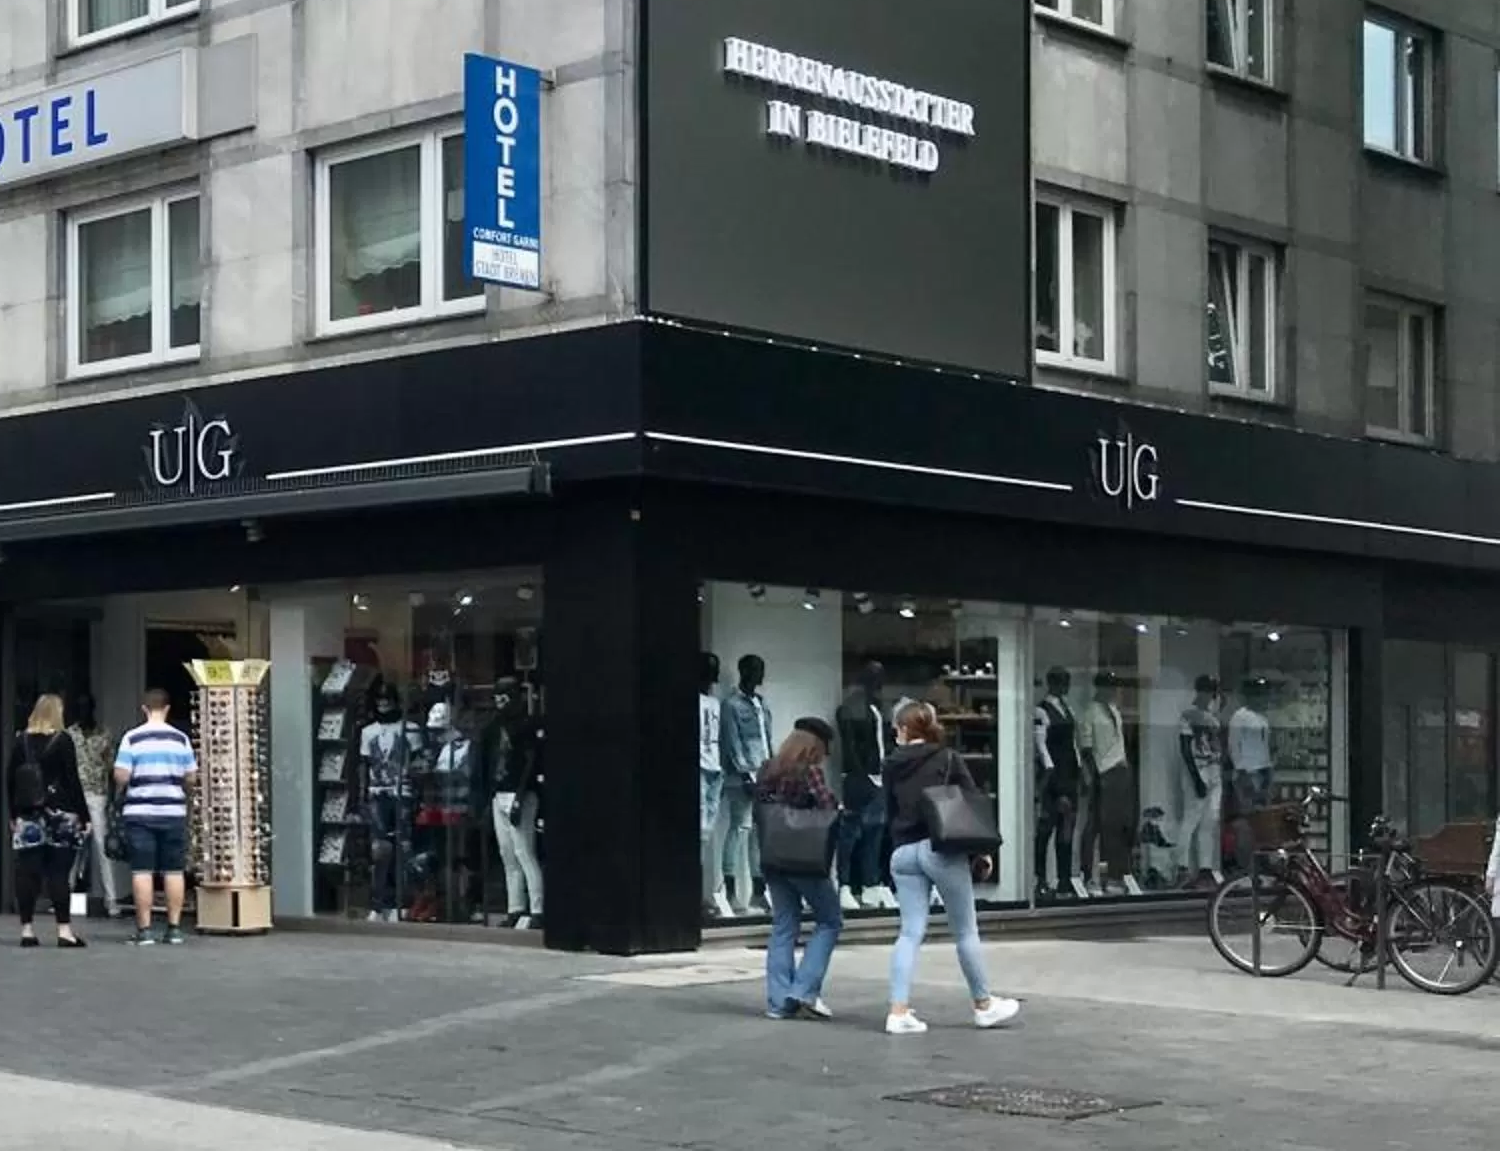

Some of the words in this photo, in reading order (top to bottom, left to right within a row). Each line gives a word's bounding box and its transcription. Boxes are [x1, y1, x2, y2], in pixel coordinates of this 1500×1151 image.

[493, 65, 519, 230] HOTEL
[767, 100, 800, 139] IN
[805, 110, 940, 172] BIELEFELD
[473, 227, 512, 245] COMFORT
